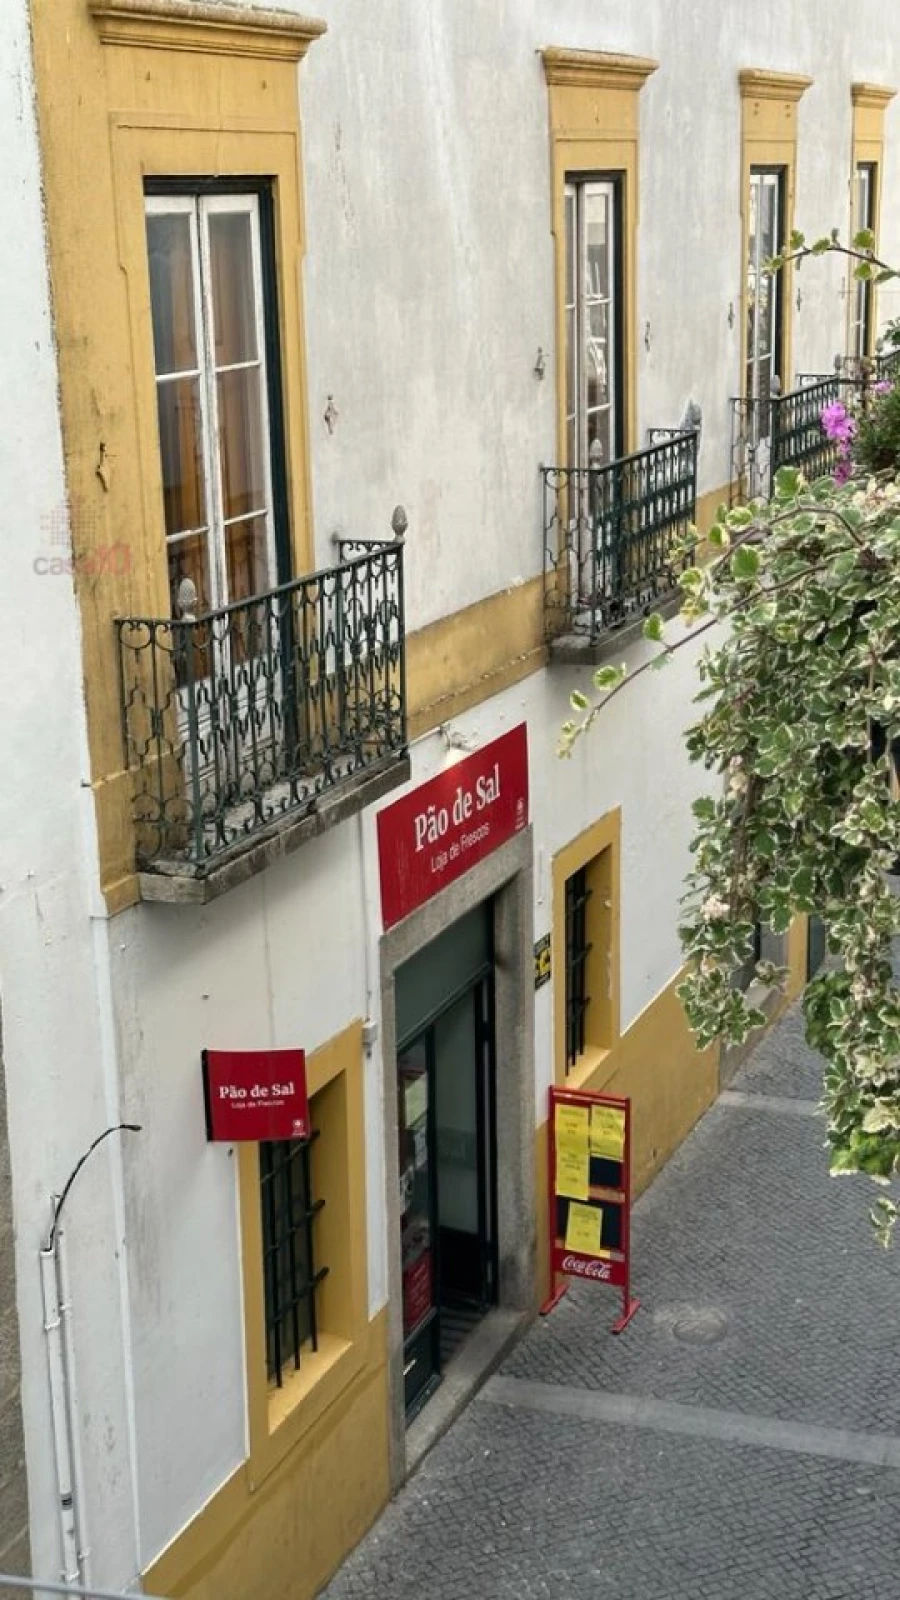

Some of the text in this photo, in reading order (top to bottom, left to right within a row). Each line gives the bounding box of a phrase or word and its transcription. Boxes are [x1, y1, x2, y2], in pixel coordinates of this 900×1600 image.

[414, 763, 500, 852] Pão de Sal
[431, 849, 448, 873] Loja
[449, 839, 460, 860] de
[460, 822, 490, 850] Frescos
[219, 1081, 295, 1099] Pão de Sal
